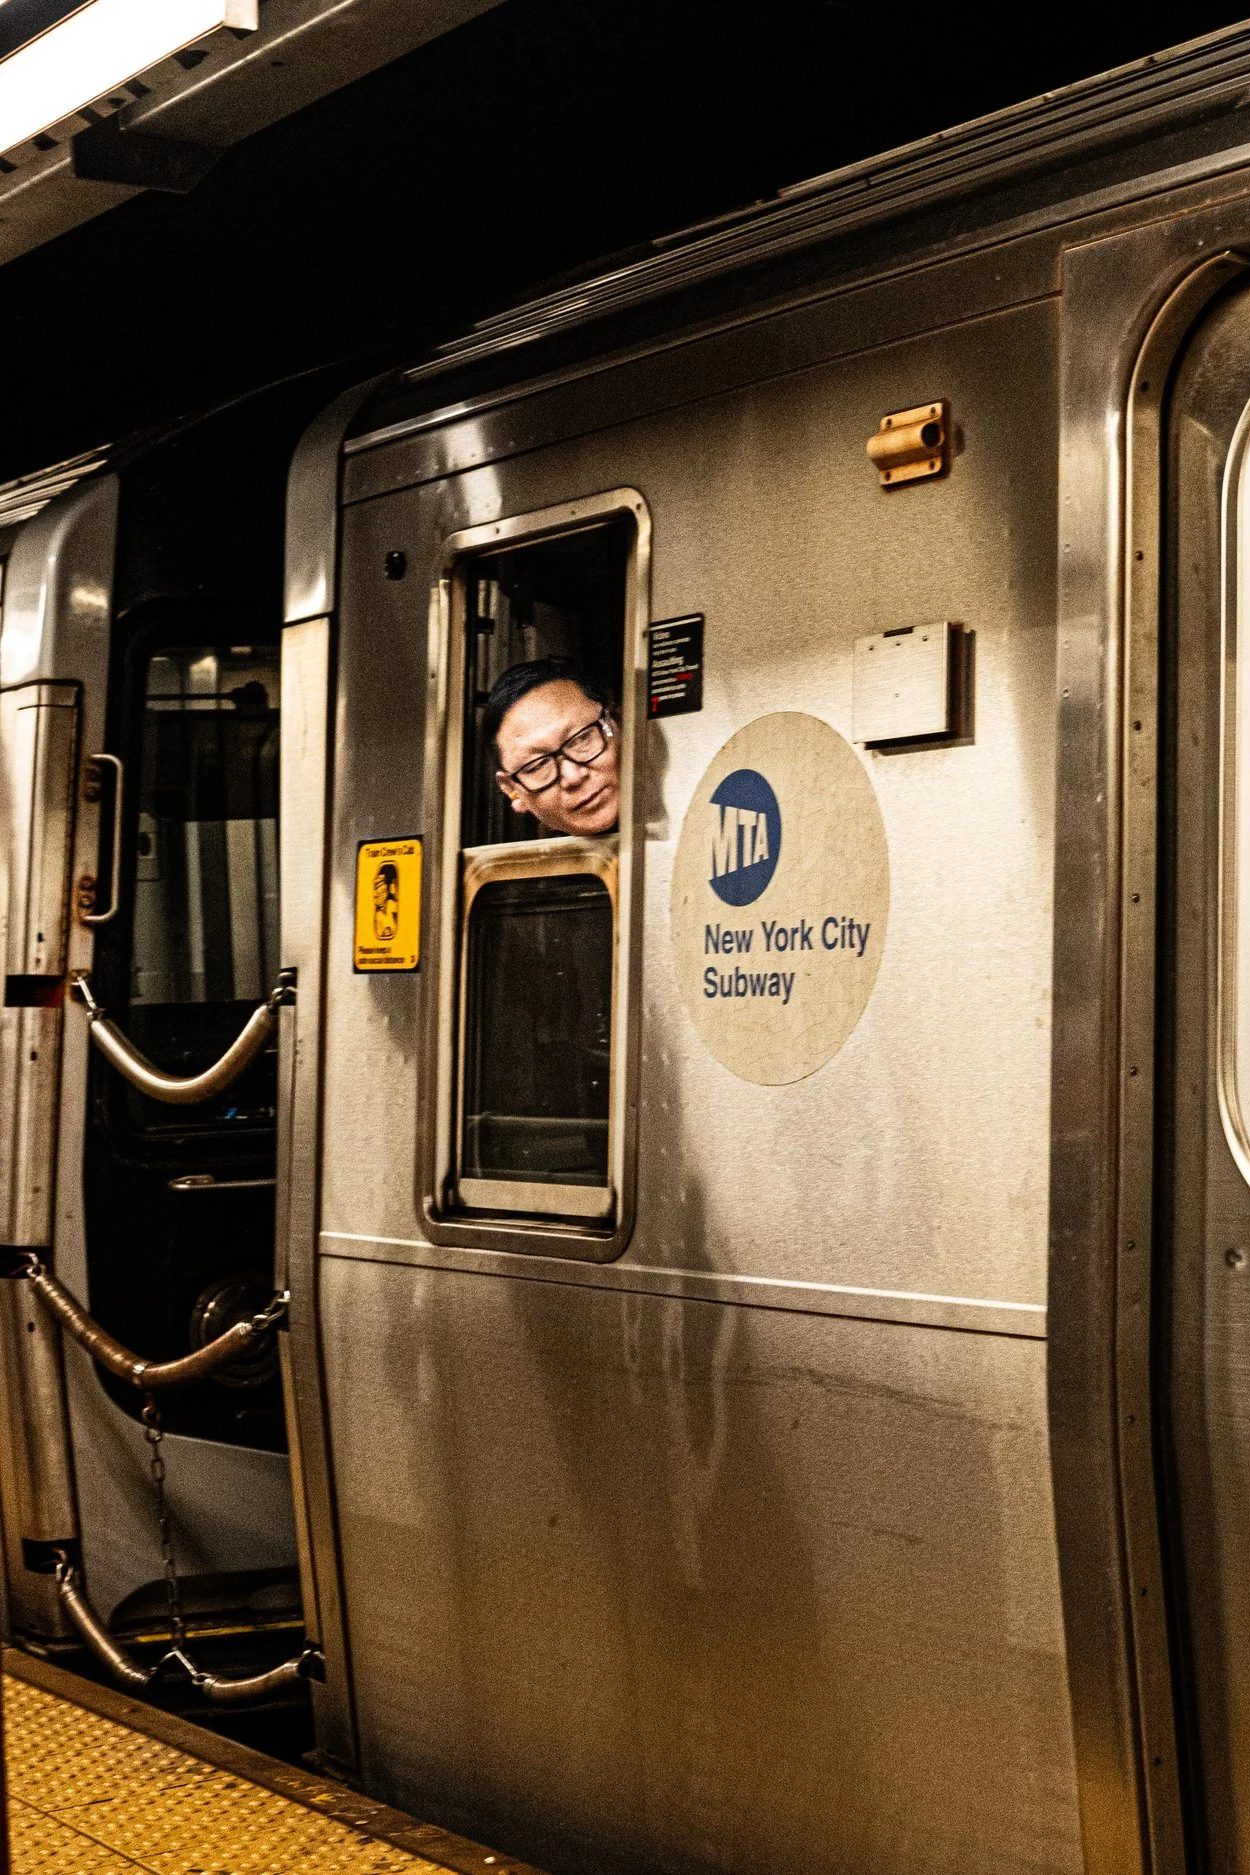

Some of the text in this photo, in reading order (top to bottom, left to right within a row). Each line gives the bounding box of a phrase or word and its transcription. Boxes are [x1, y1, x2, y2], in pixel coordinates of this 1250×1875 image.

[710, 802, 769, 881] MTA
[704, 916, 871, 957] New York City
[702, 966, 796, 1005] Subway
